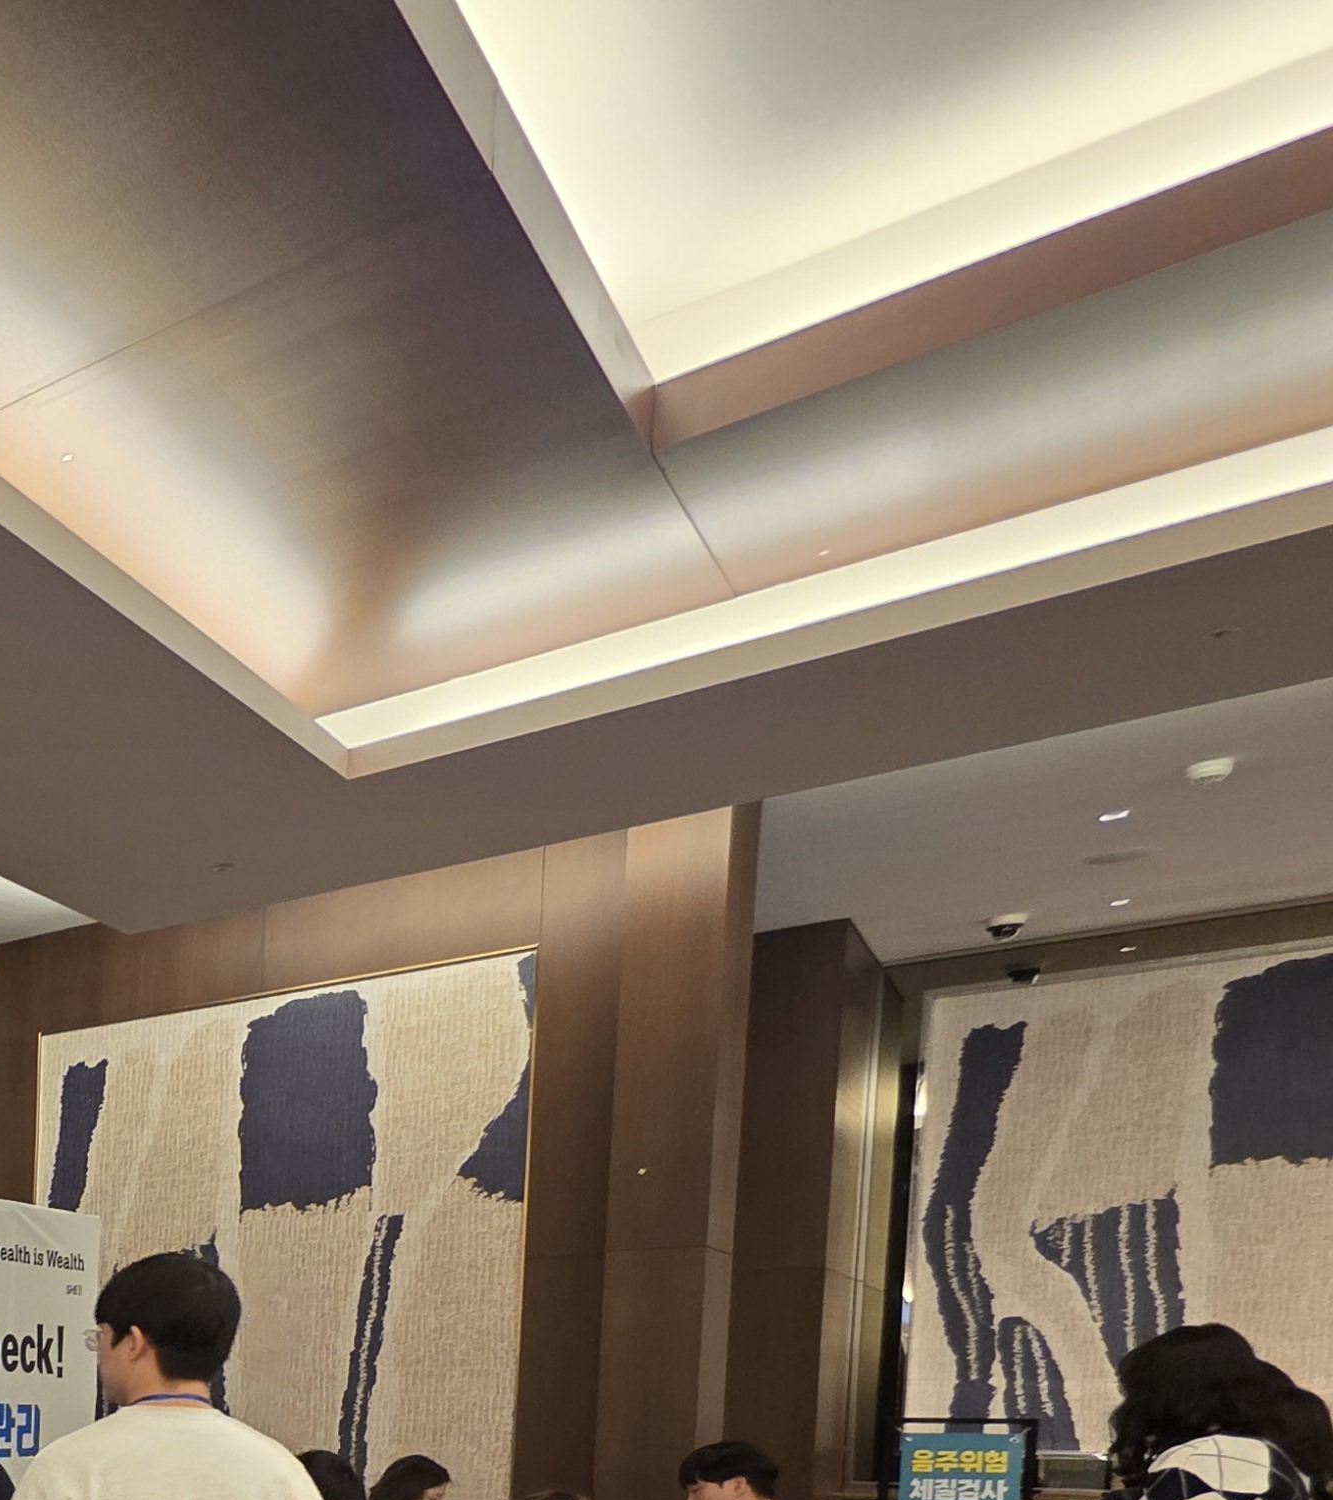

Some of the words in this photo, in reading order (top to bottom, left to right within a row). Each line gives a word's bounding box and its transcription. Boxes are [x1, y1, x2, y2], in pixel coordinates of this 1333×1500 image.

[33, 1247, 44, 1266] is
[46, 1249, 85, 1272] Wealth
[911, 1449, 1009, 1474] 음주위험
